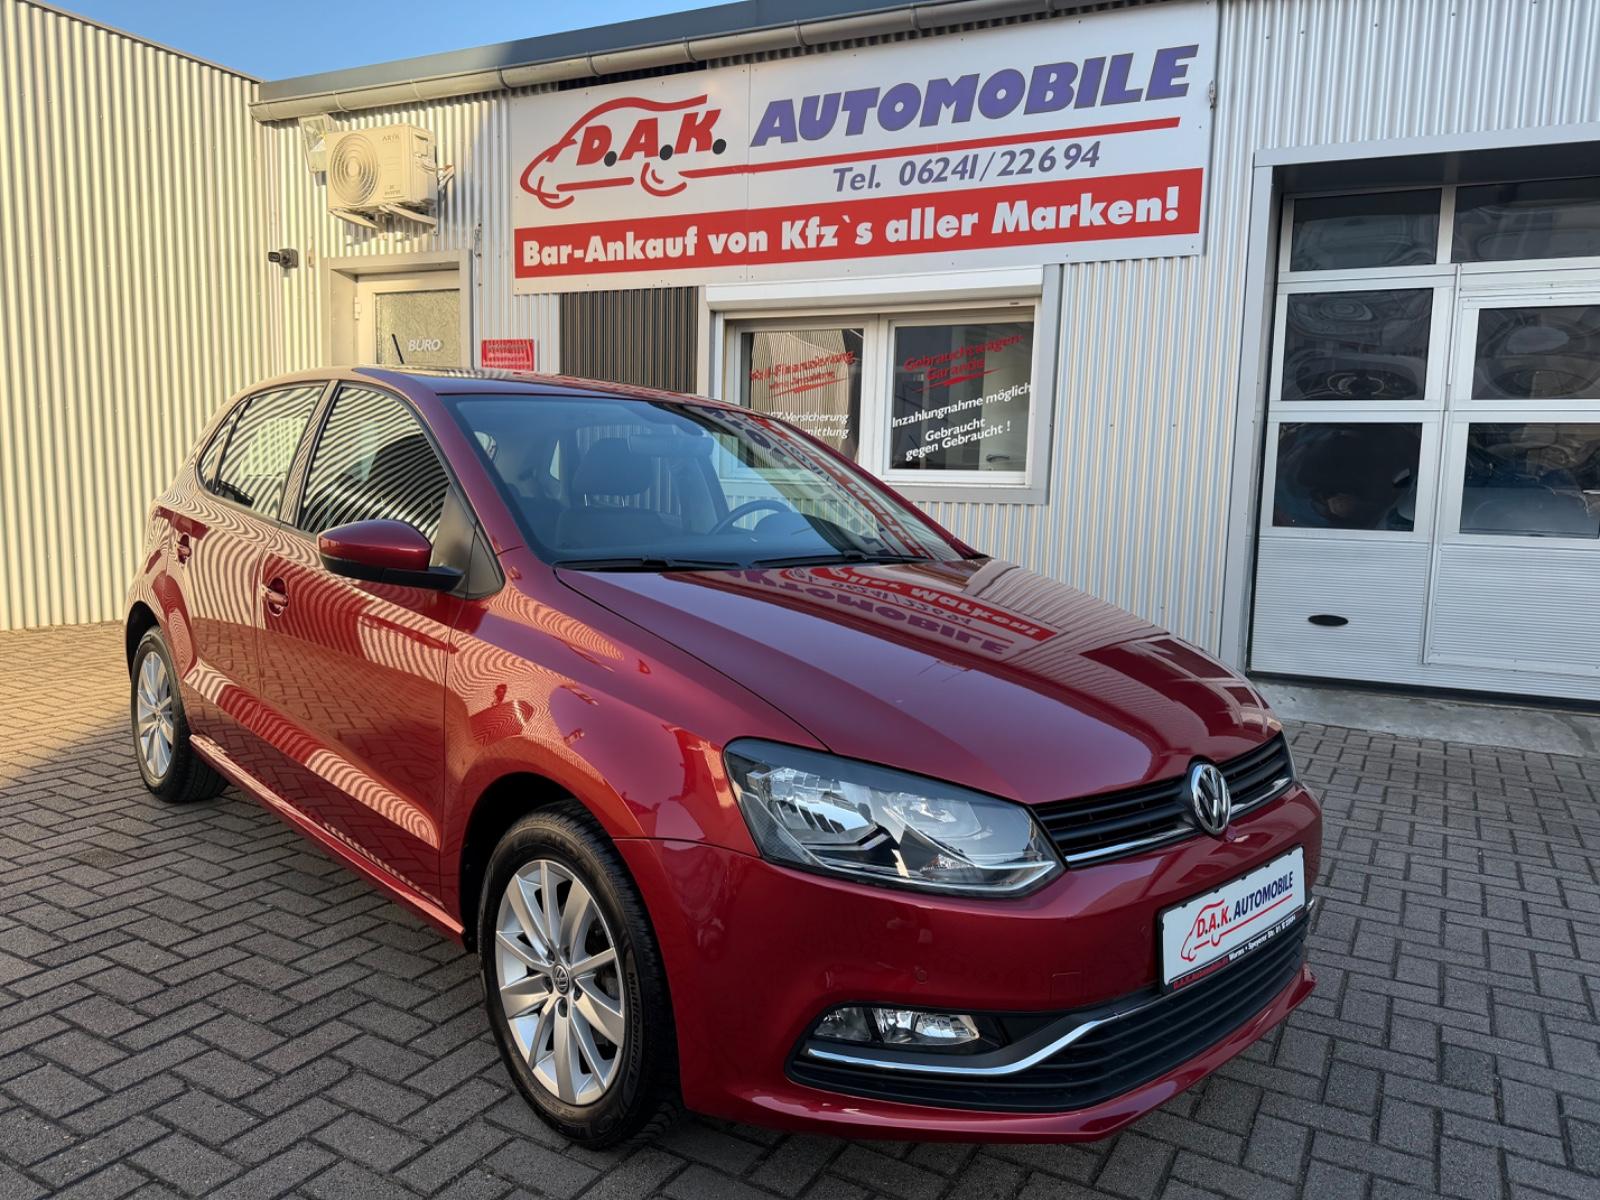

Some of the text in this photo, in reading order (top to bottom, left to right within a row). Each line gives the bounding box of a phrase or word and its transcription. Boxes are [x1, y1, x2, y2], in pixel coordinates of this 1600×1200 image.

[576, 44, 1199, 167] D.A.K. AUTOMOBILE
[833, 164, 881, 192] Tel.
[522, 225, 698, 267] Bar-Ankauf
[708, 230, 768, 255] von
[885, 206, 979, 243] aller
[991, 186, 1180, 234] Marken!
[892, 382, 1032, 428] Inzahlungnahme möglich
[905, 444, 939, 462] gegen
[941, 423, 1003, 449] Gebraucht
[925, 417, 986, 441] Gebraucht
[1197, 906, 1232, 938] D.A.K.
[1233, 871, 1293, 920] AUTOMOBILE
